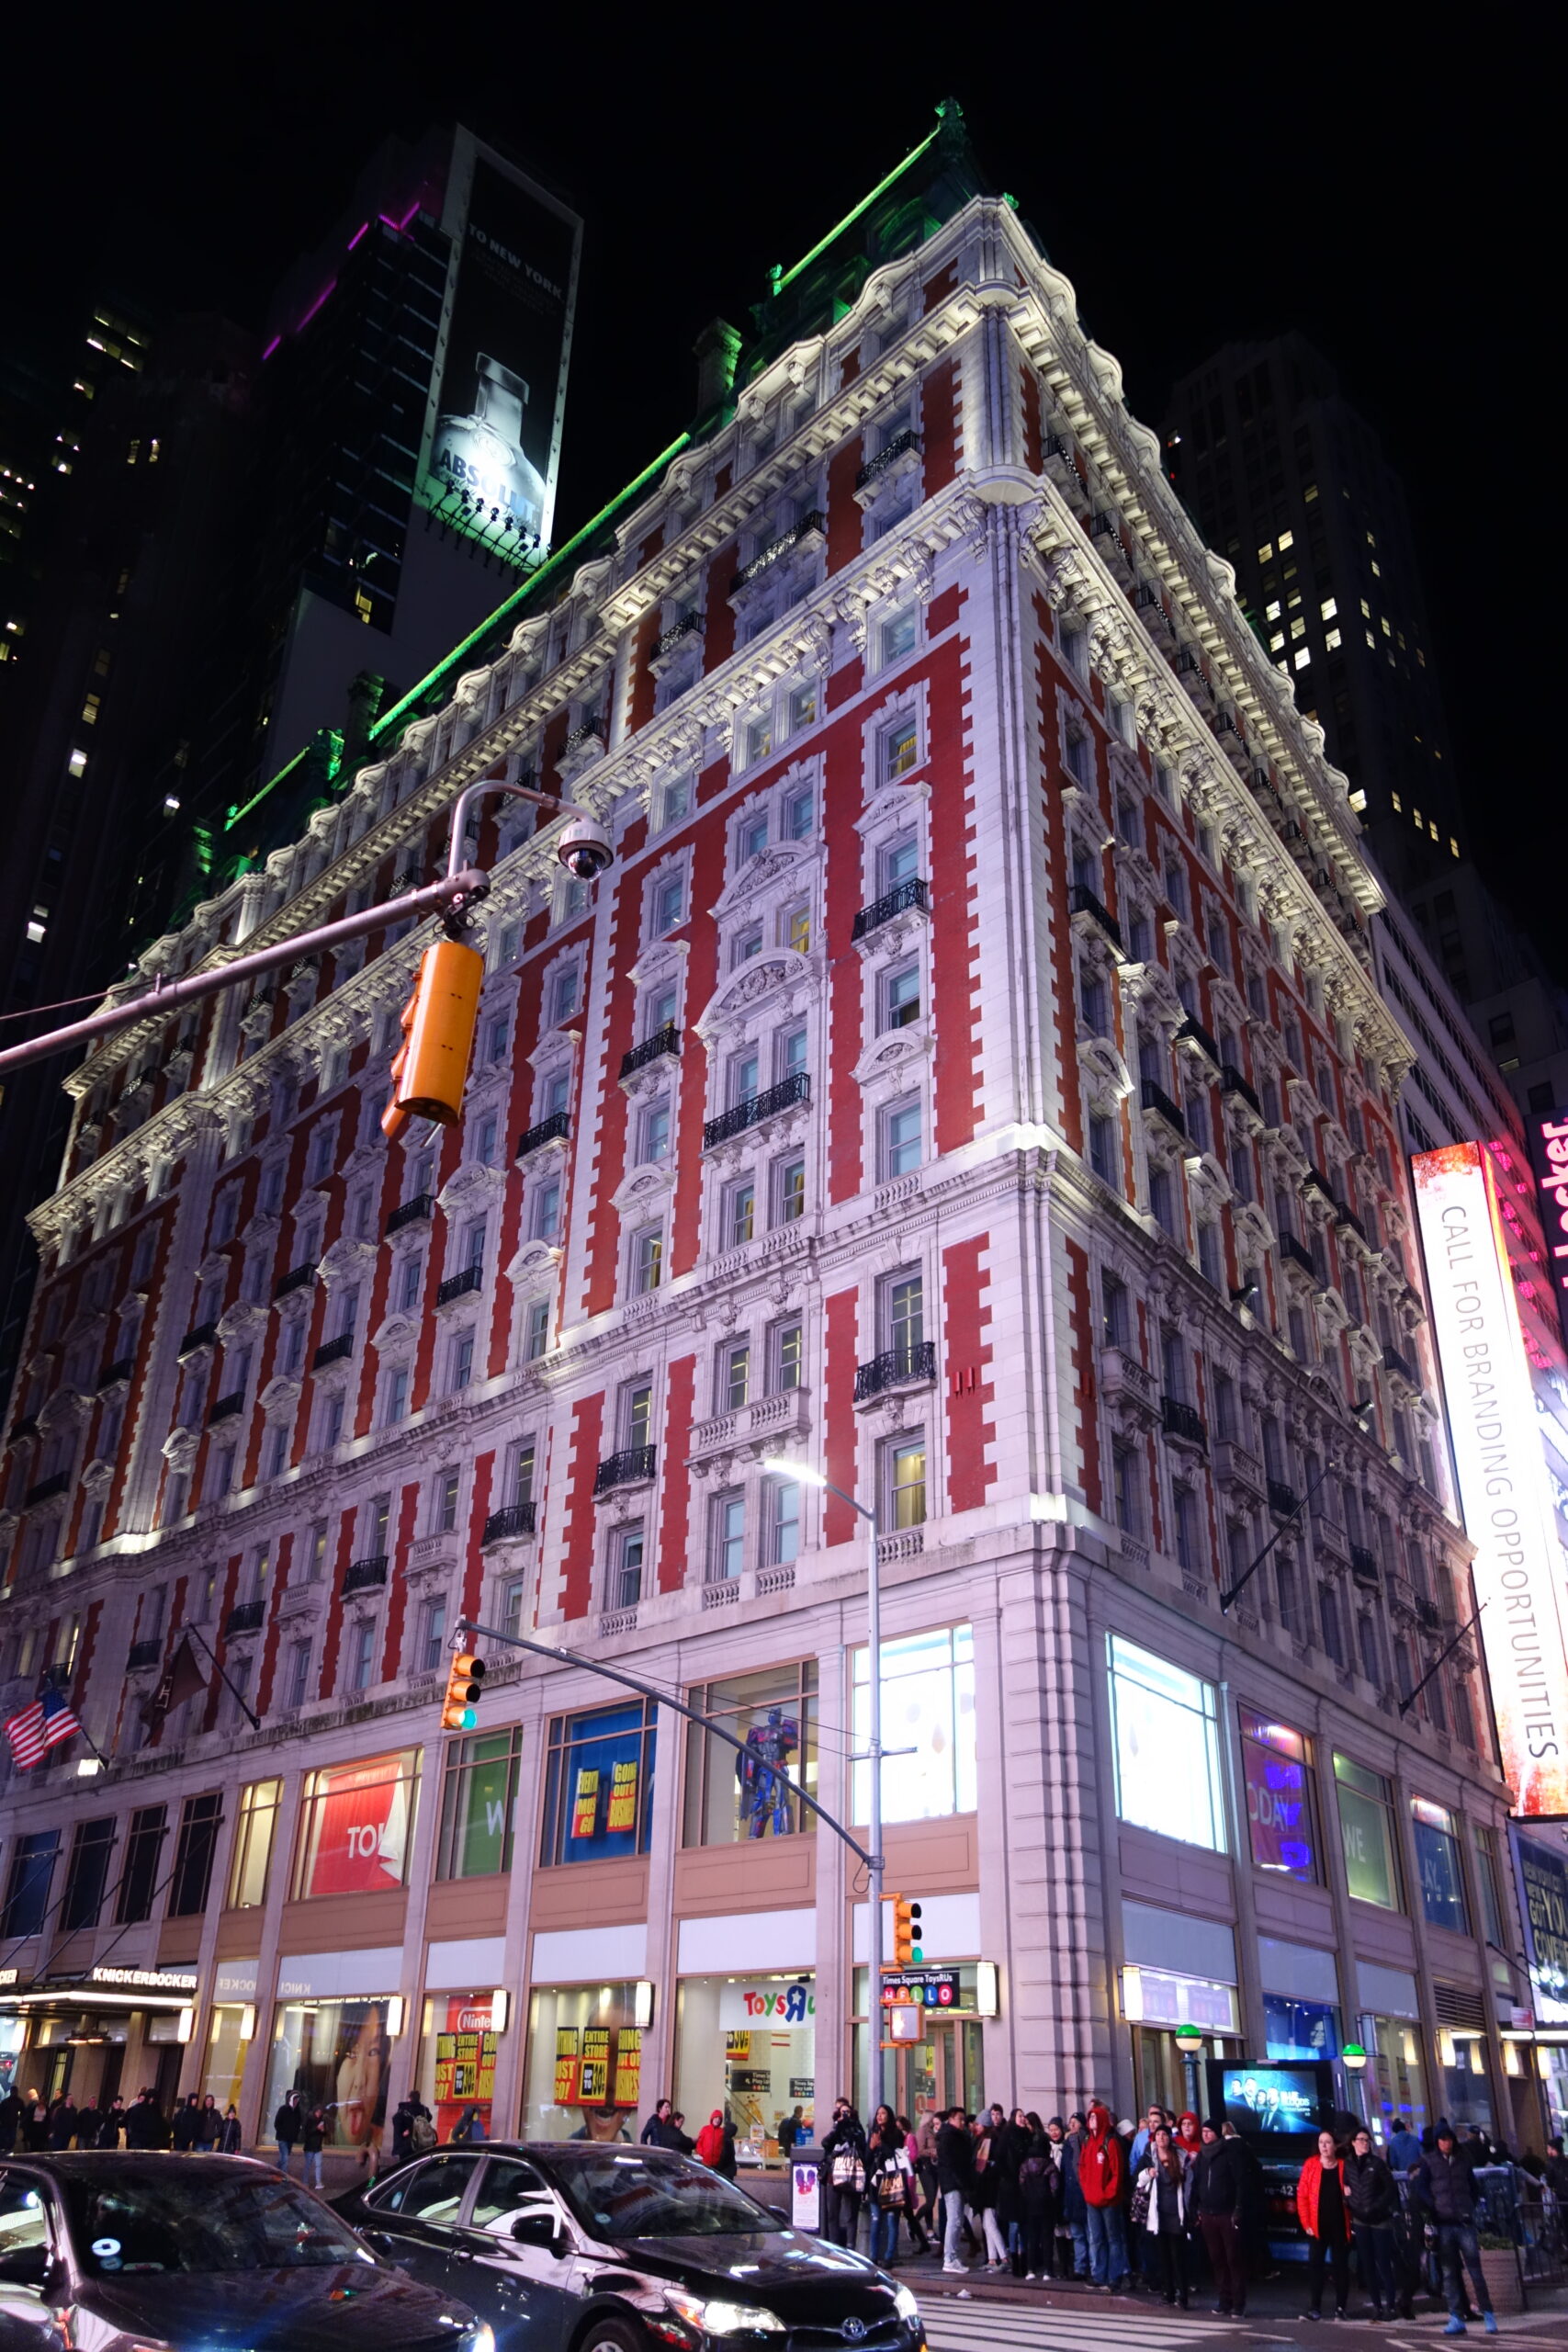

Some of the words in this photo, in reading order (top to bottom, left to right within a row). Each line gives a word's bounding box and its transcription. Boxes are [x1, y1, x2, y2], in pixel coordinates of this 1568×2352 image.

[468, 221, 488, 244] TO
[490, 238, 522, 268] NEW
[524, 265, 564, 300] YORK
[440, 447, 536, 526] ABSOLUT
[1441, 1205, 1473, 1270] CALL
[1452, 1281, 1484, 1334] FOR
[1463, 1342, 1513, 1497] BRANDING
[1490, 1508, 1559, 1758] OPPORTUNITIES
[93, 1967, 197, 1989] KNICKERBOCKER
[883, 1976, 900, 1984] Times
[901, 1974, 924, 1986] Square
[583, 2044, 609, 2059] STORE
[584, 2030, 609, 2043] ENTIRE
[583, 2079, 592, 2089] TO
[584, 2069, 593, 2079] UP
